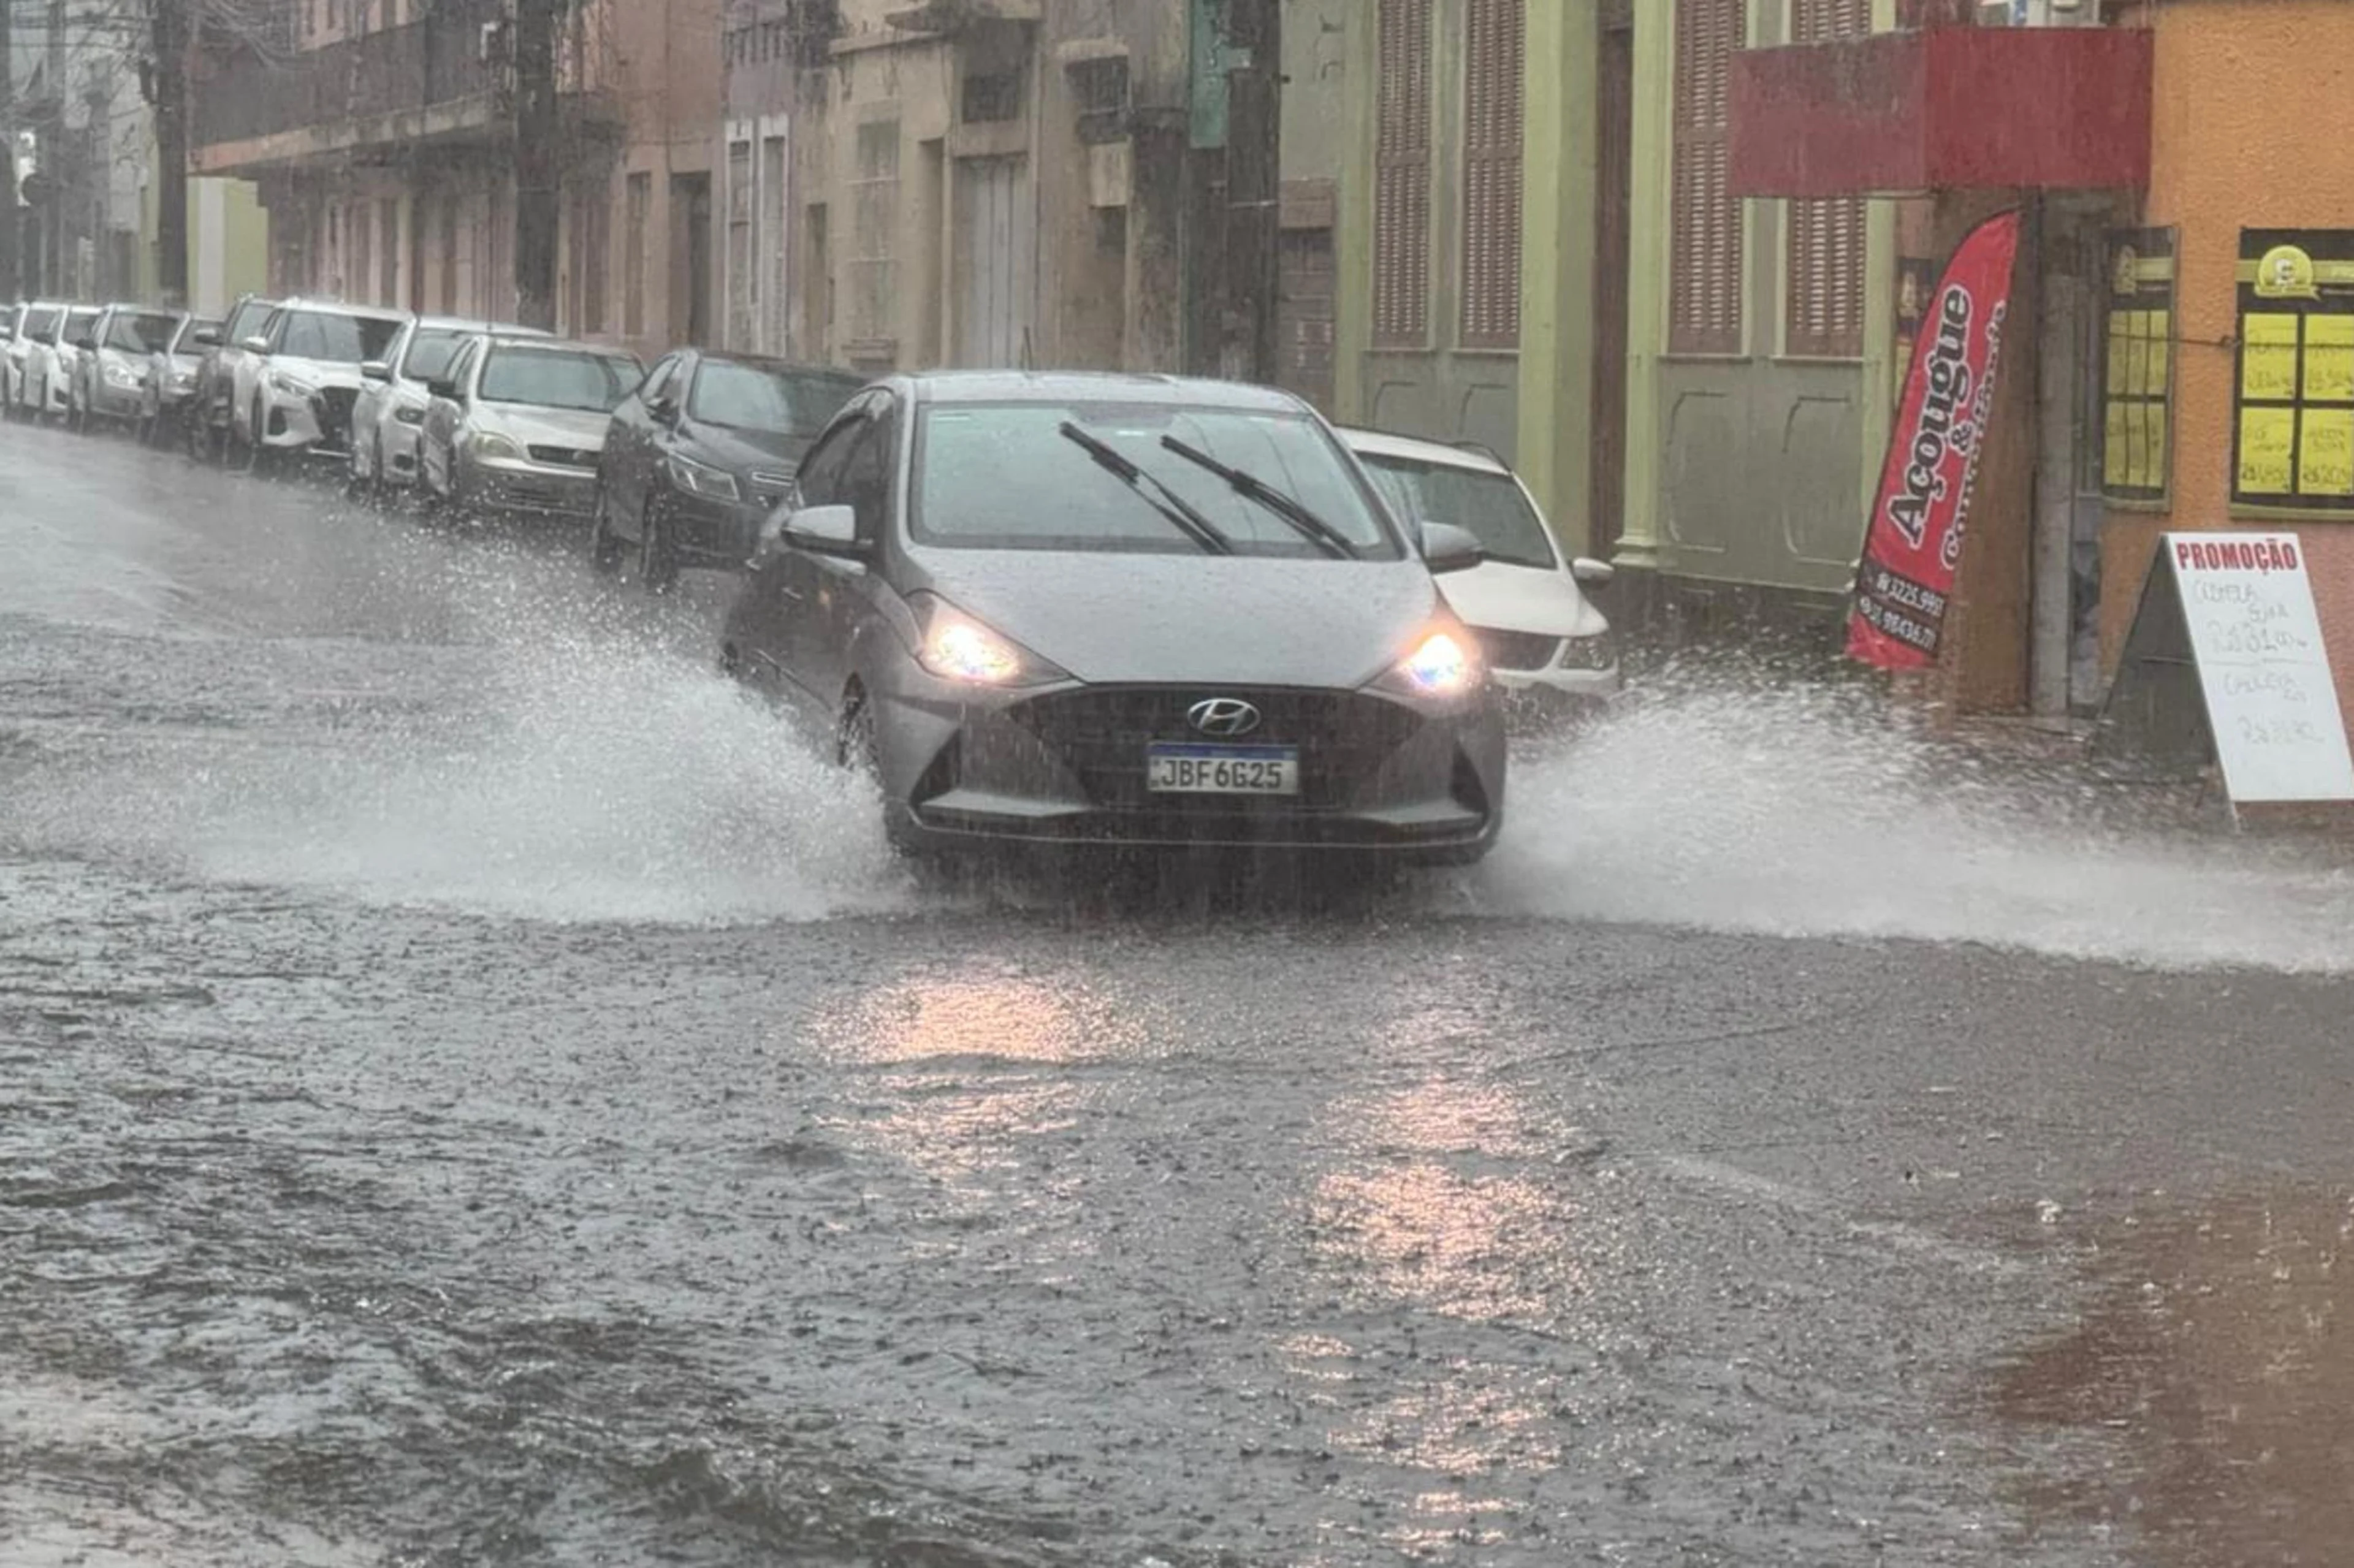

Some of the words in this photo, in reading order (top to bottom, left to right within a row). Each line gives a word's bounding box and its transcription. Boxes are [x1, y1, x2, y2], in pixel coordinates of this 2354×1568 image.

[1888, 285, 1972, 549] Açougue
[1951, 422, 1974, 455] &
[2176, 538, 2298, 575] PROMOÇÃO
[1161, 759, 1282, 788] JBF6G25
